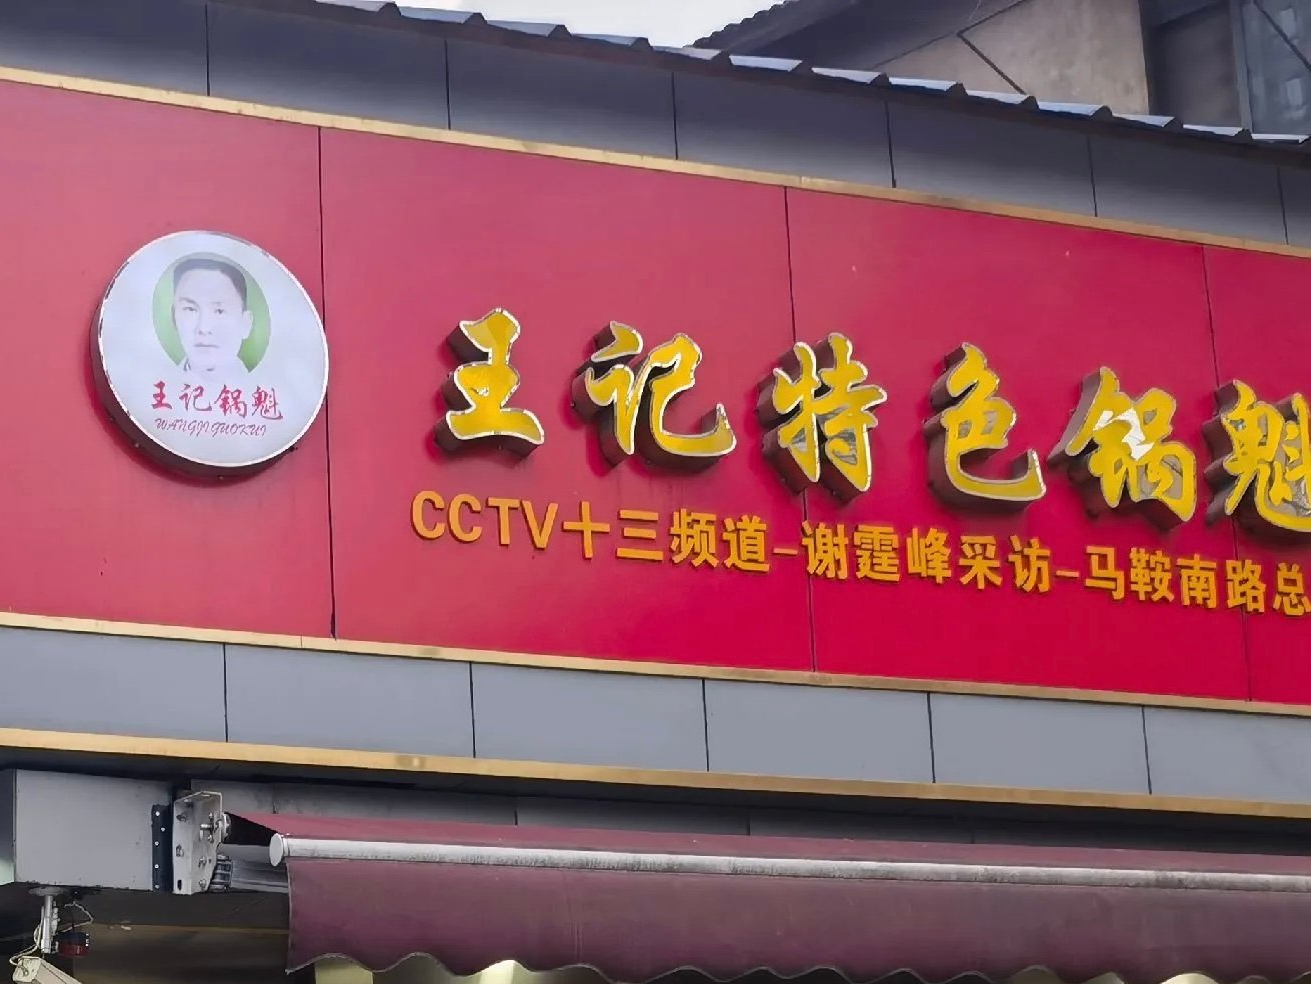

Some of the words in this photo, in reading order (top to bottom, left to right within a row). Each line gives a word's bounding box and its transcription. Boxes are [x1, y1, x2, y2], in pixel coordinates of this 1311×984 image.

[151, 380, 283, 421] 王记锅魁
[439, 307, 1311, 532] 王记特色锅魁
